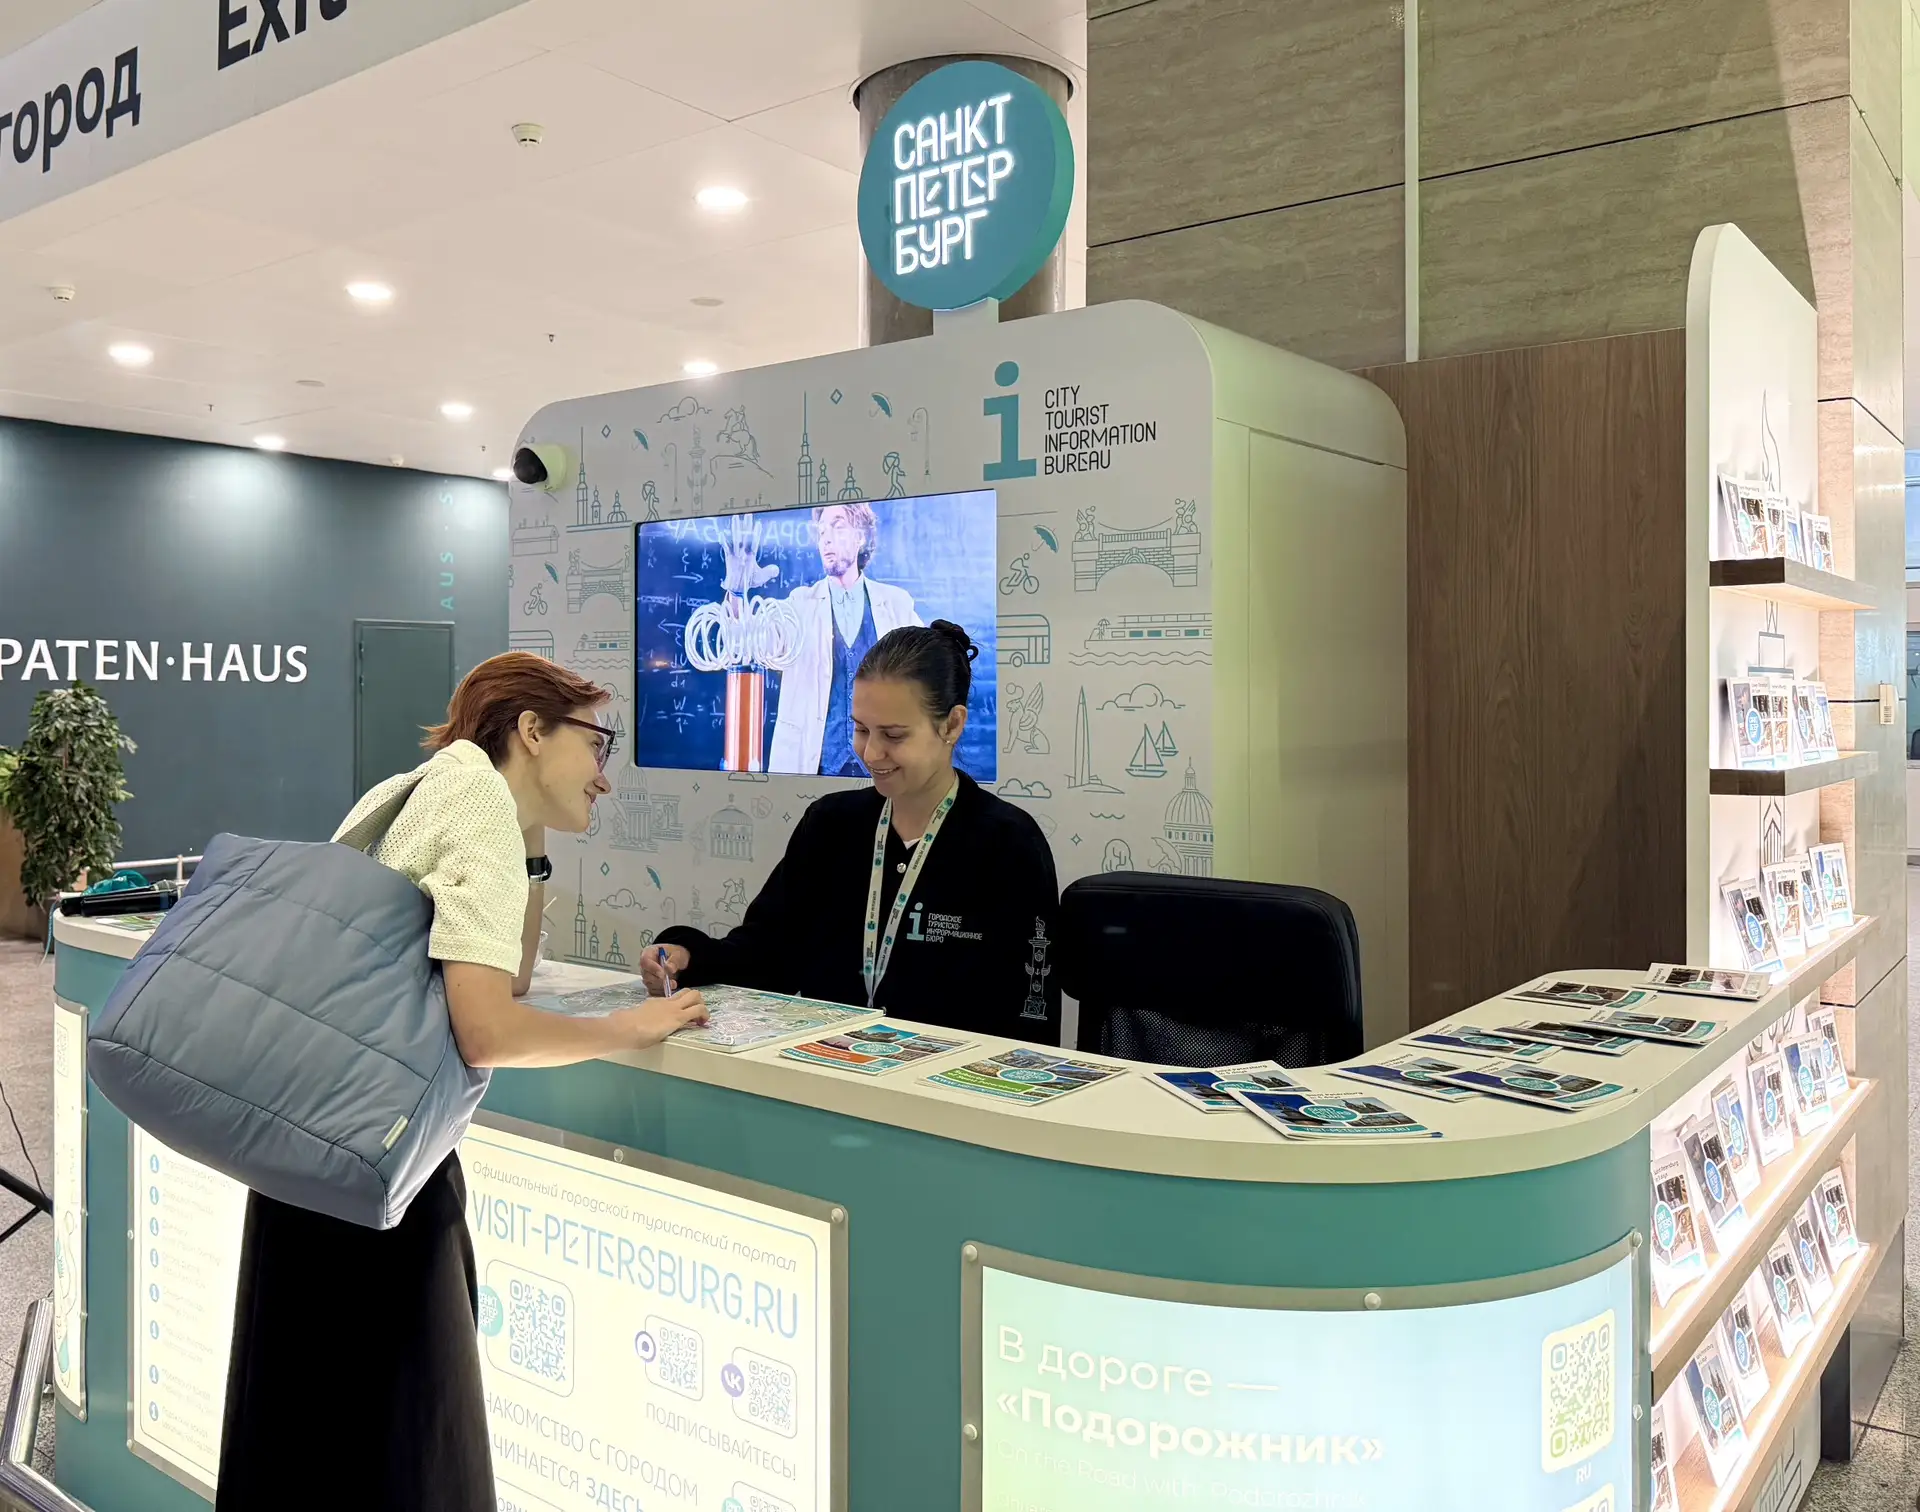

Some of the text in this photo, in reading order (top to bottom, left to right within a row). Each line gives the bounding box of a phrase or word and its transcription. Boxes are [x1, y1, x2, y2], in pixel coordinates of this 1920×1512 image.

[217, 0, 348, 70] Ex
[894, 93, 1012, 170] САНКТ
[895, 150, 1014, 224] ПЕТЕР
[896, 209, 989, 275] БУРГ
[1044, 385, 1080, 409] CITY
[1045, 404, 1109, 430] TOURIST
[1044, 449, 1111, 475] BUREAU
[1045, 421, 1156, 453] INFORMATION
[925, 934, 944, 943] БЮРО
[473, 1161, 797, 1273] Официальный городской туристский портал
[472, 1190, 798, 1339] VISIT-PETERSBURG.RU
[999, 1325, 1026, 1363] В
[1038, 1344, 1213, 1397] дороге
[486, 1392, 698, 1506] НАКОМСТВО С ГОРОДОМ
[645, 1402, 797, 1481] ПОДПИСЫВАЙТЕСЬ!
[996, 1387, 1385, 1465] «Подорожник»
[492, 1433, 579, 1492] ЧИНАЕТСЯ
[1078, 1459, 1137, 1492] Road
[1575, 1462, 1592, 1485] RU
